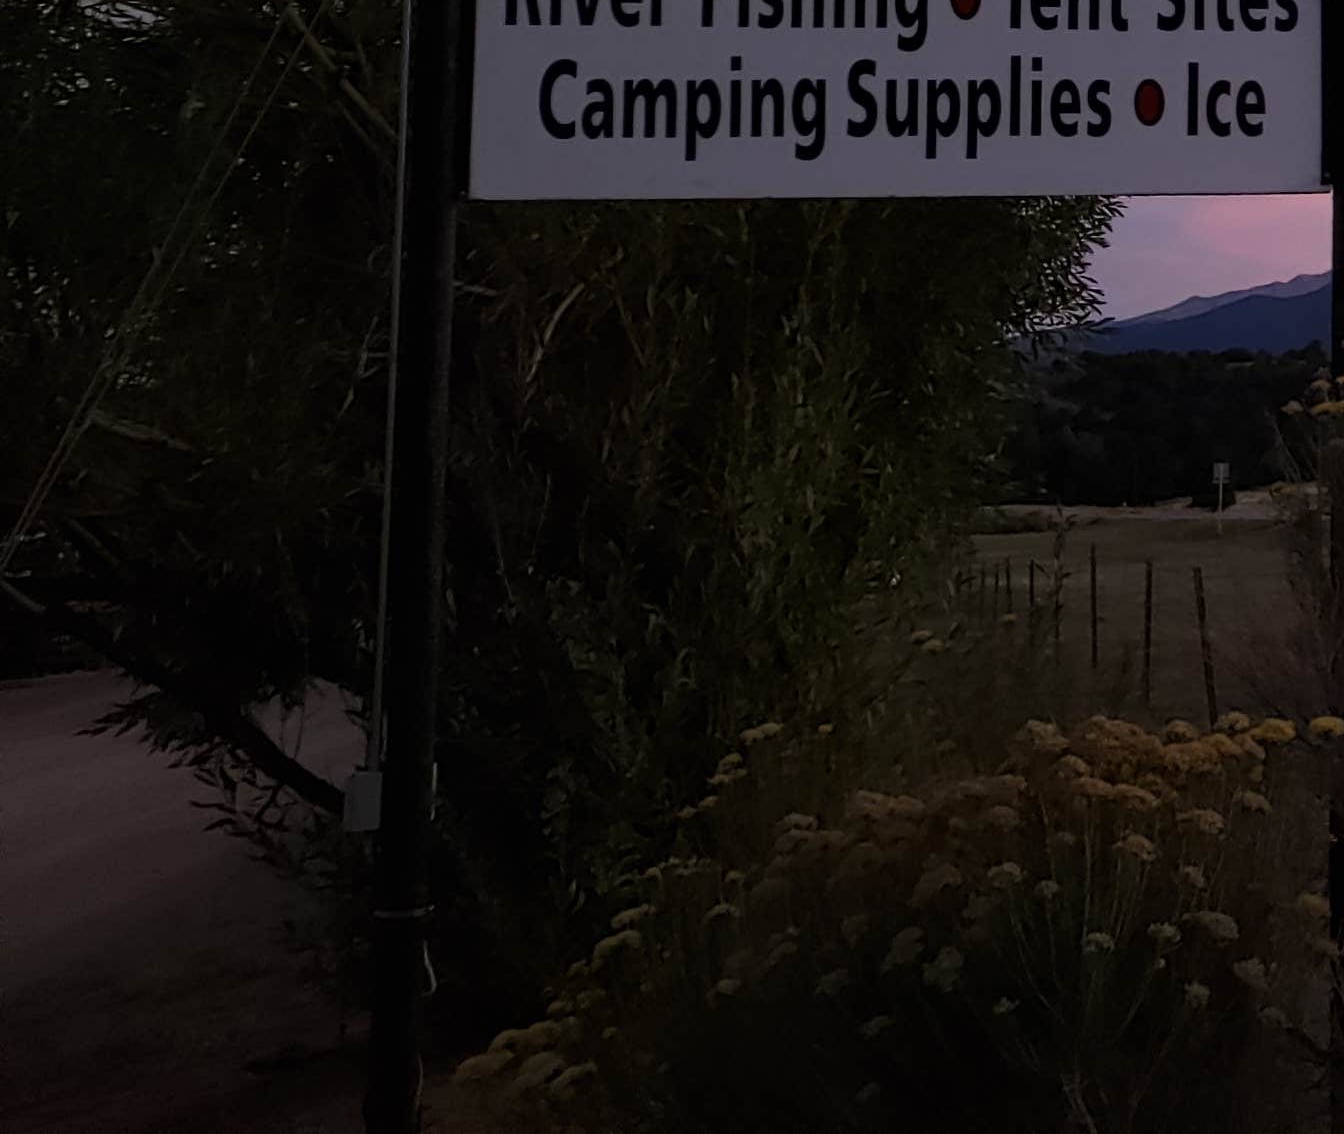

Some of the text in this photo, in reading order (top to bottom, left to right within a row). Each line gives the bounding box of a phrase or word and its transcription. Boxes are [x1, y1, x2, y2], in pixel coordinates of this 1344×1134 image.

[538, 56, 1268, 162] Camping Supplies Ice
